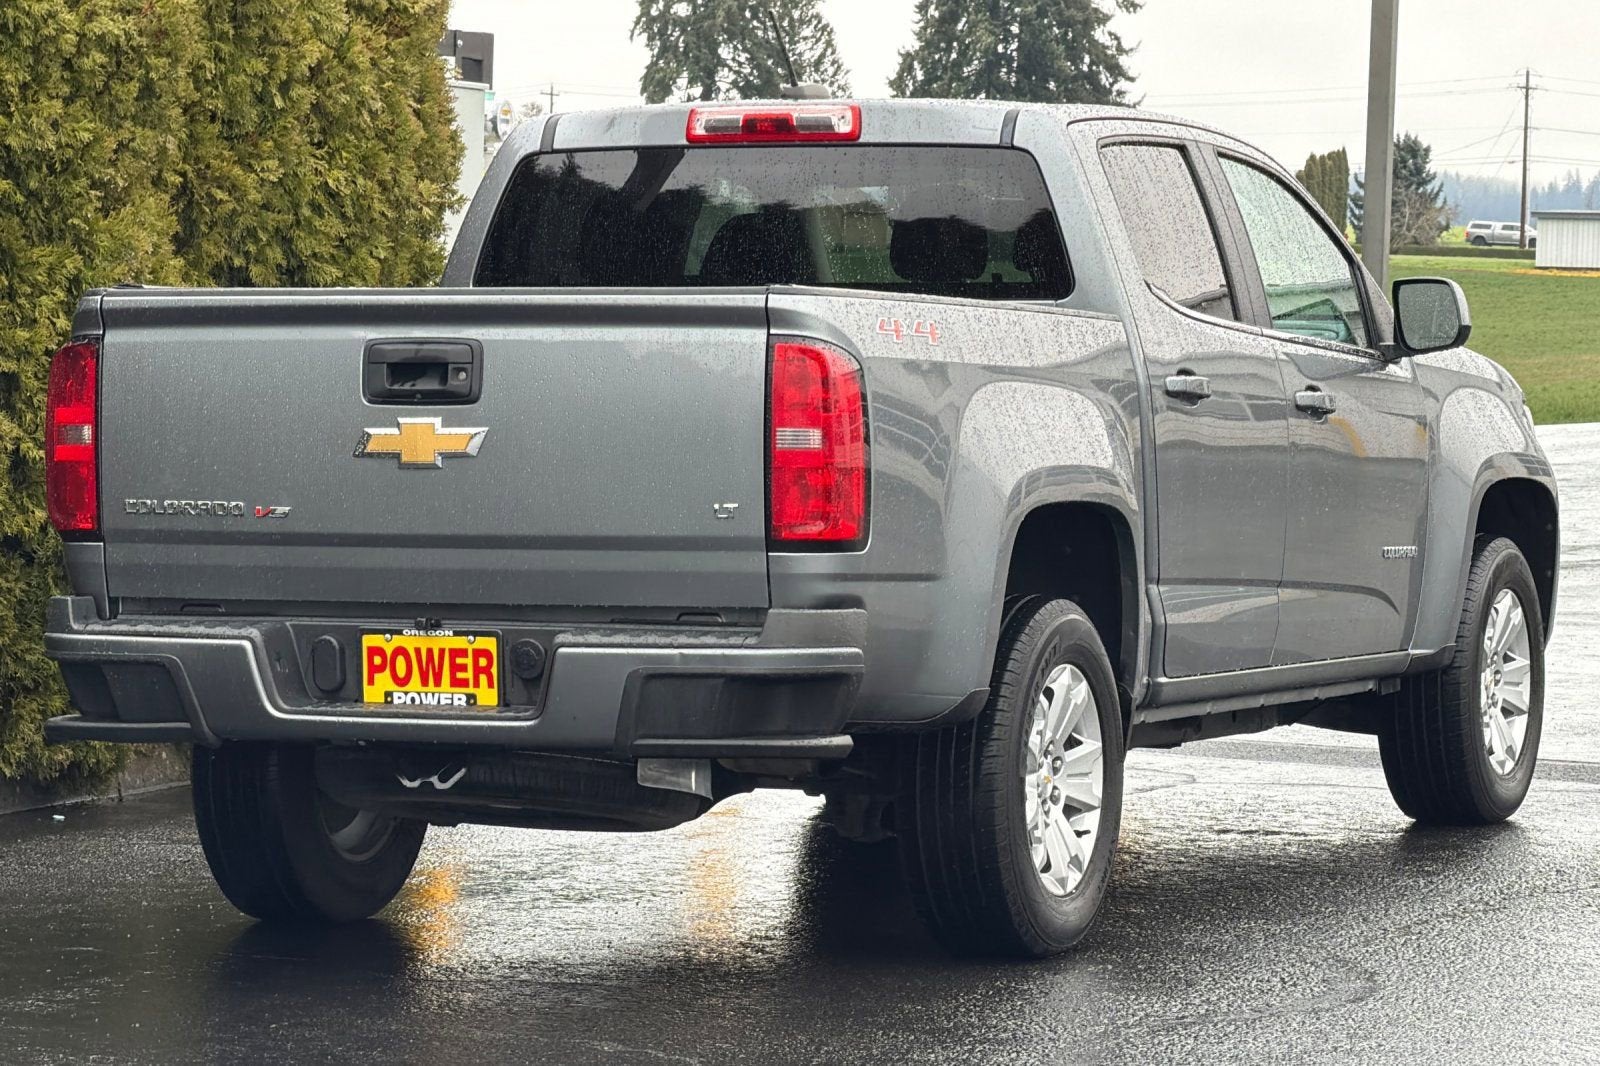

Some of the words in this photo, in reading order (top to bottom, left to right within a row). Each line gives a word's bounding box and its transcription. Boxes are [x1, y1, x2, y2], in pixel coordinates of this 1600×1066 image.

[125, 499, 244, 515] COLORADO
[402, 629, 453, 637] OREGON
[366, 645, 495, 689] POWER
[393, 691, 467, 707] POWER
